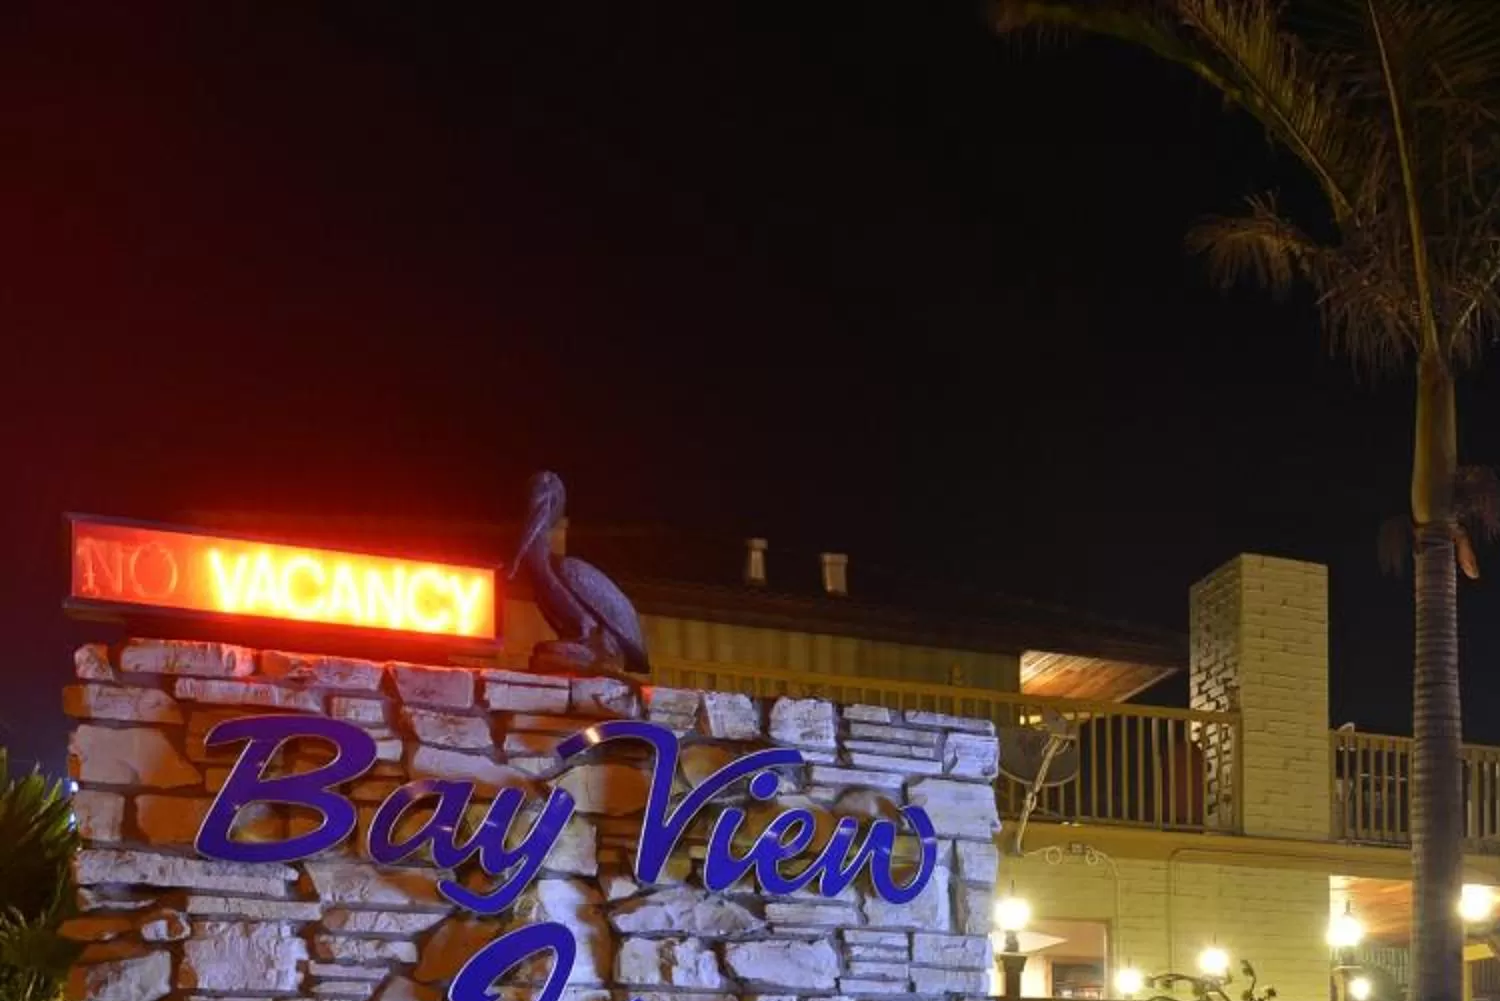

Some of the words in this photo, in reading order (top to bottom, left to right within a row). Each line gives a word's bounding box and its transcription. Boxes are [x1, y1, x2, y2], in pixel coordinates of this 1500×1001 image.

[76, 537, 178, 597] NO
[208, 546, 484, 636] VACANCY
[197, 714, 575, 915] Bay
[556, 719, 938, 904] View
